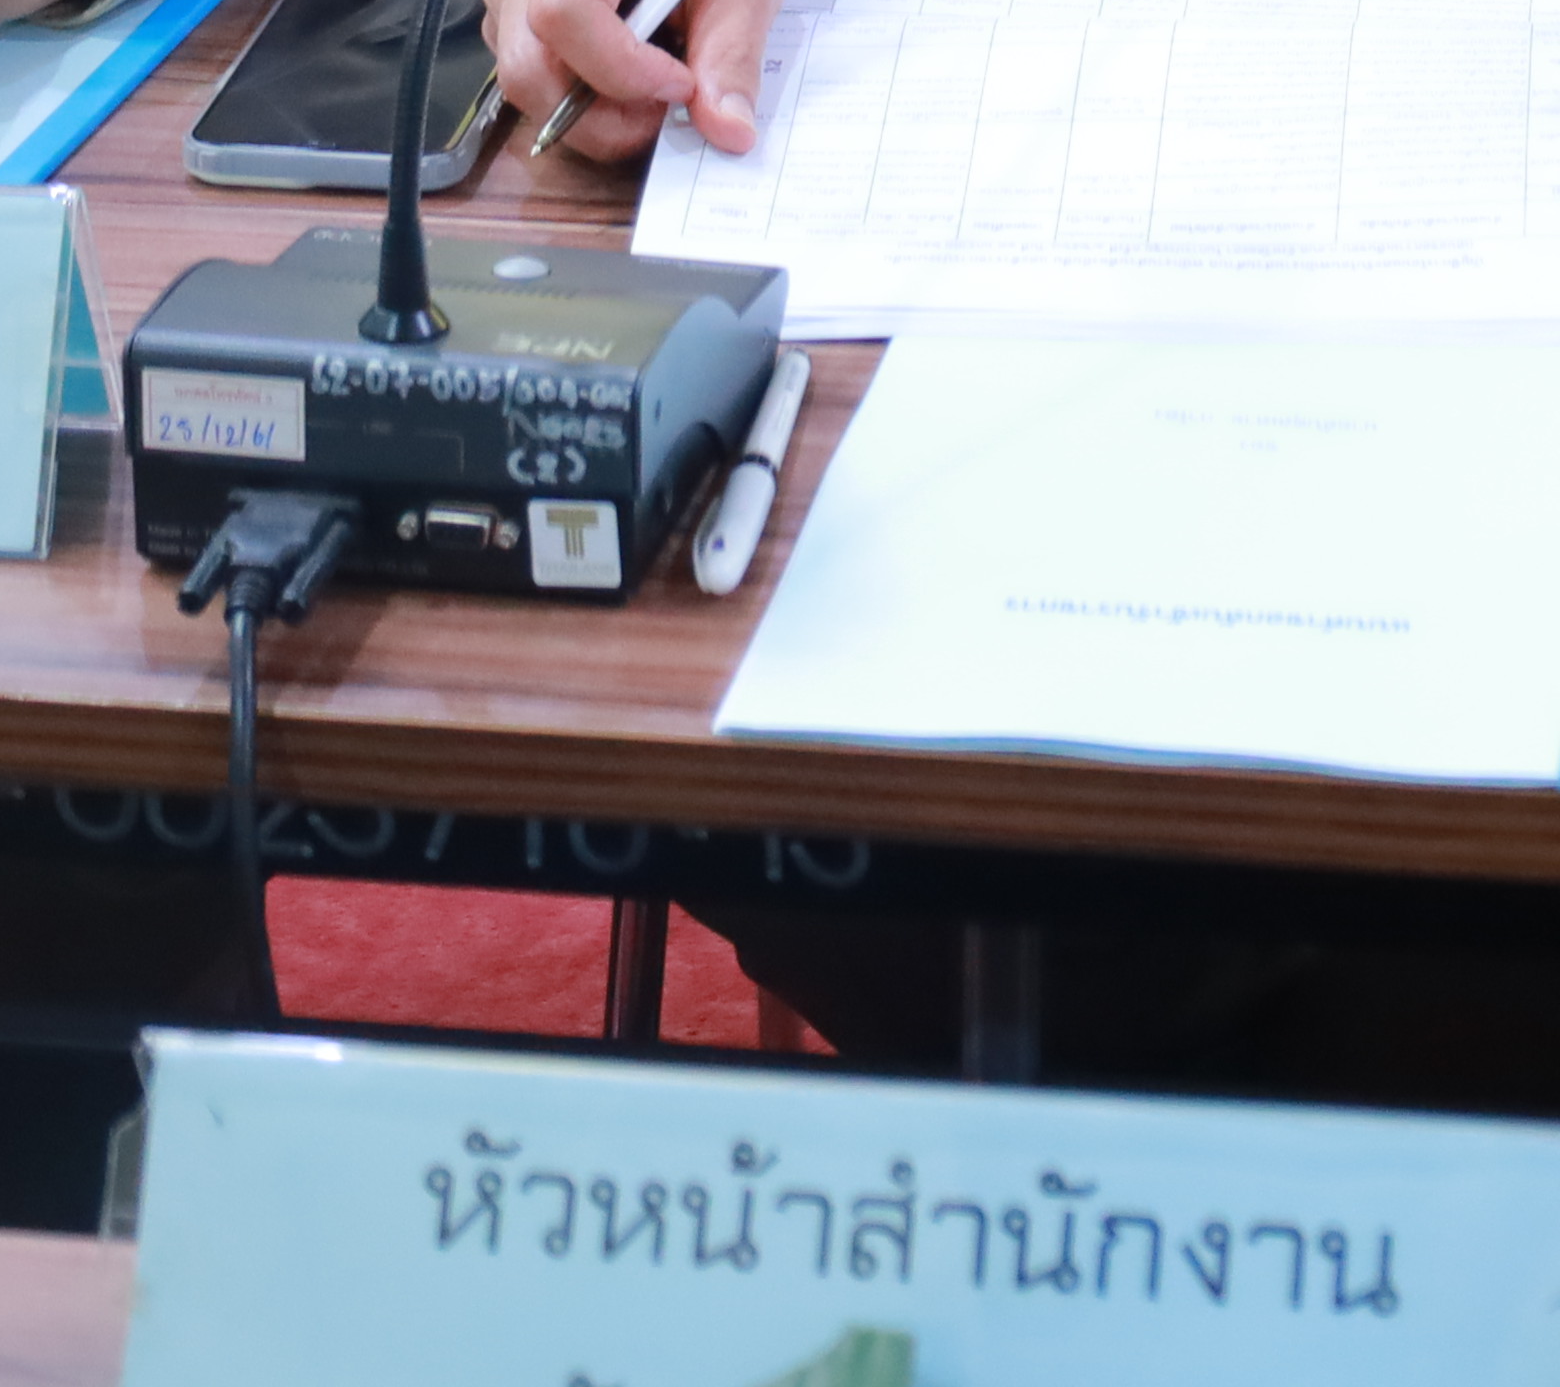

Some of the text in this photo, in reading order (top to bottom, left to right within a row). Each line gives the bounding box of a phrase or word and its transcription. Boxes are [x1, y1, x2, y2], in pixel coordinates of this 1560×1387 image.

[425, 1128, 1402, 1316] หัวหน้าสำนักงาน
